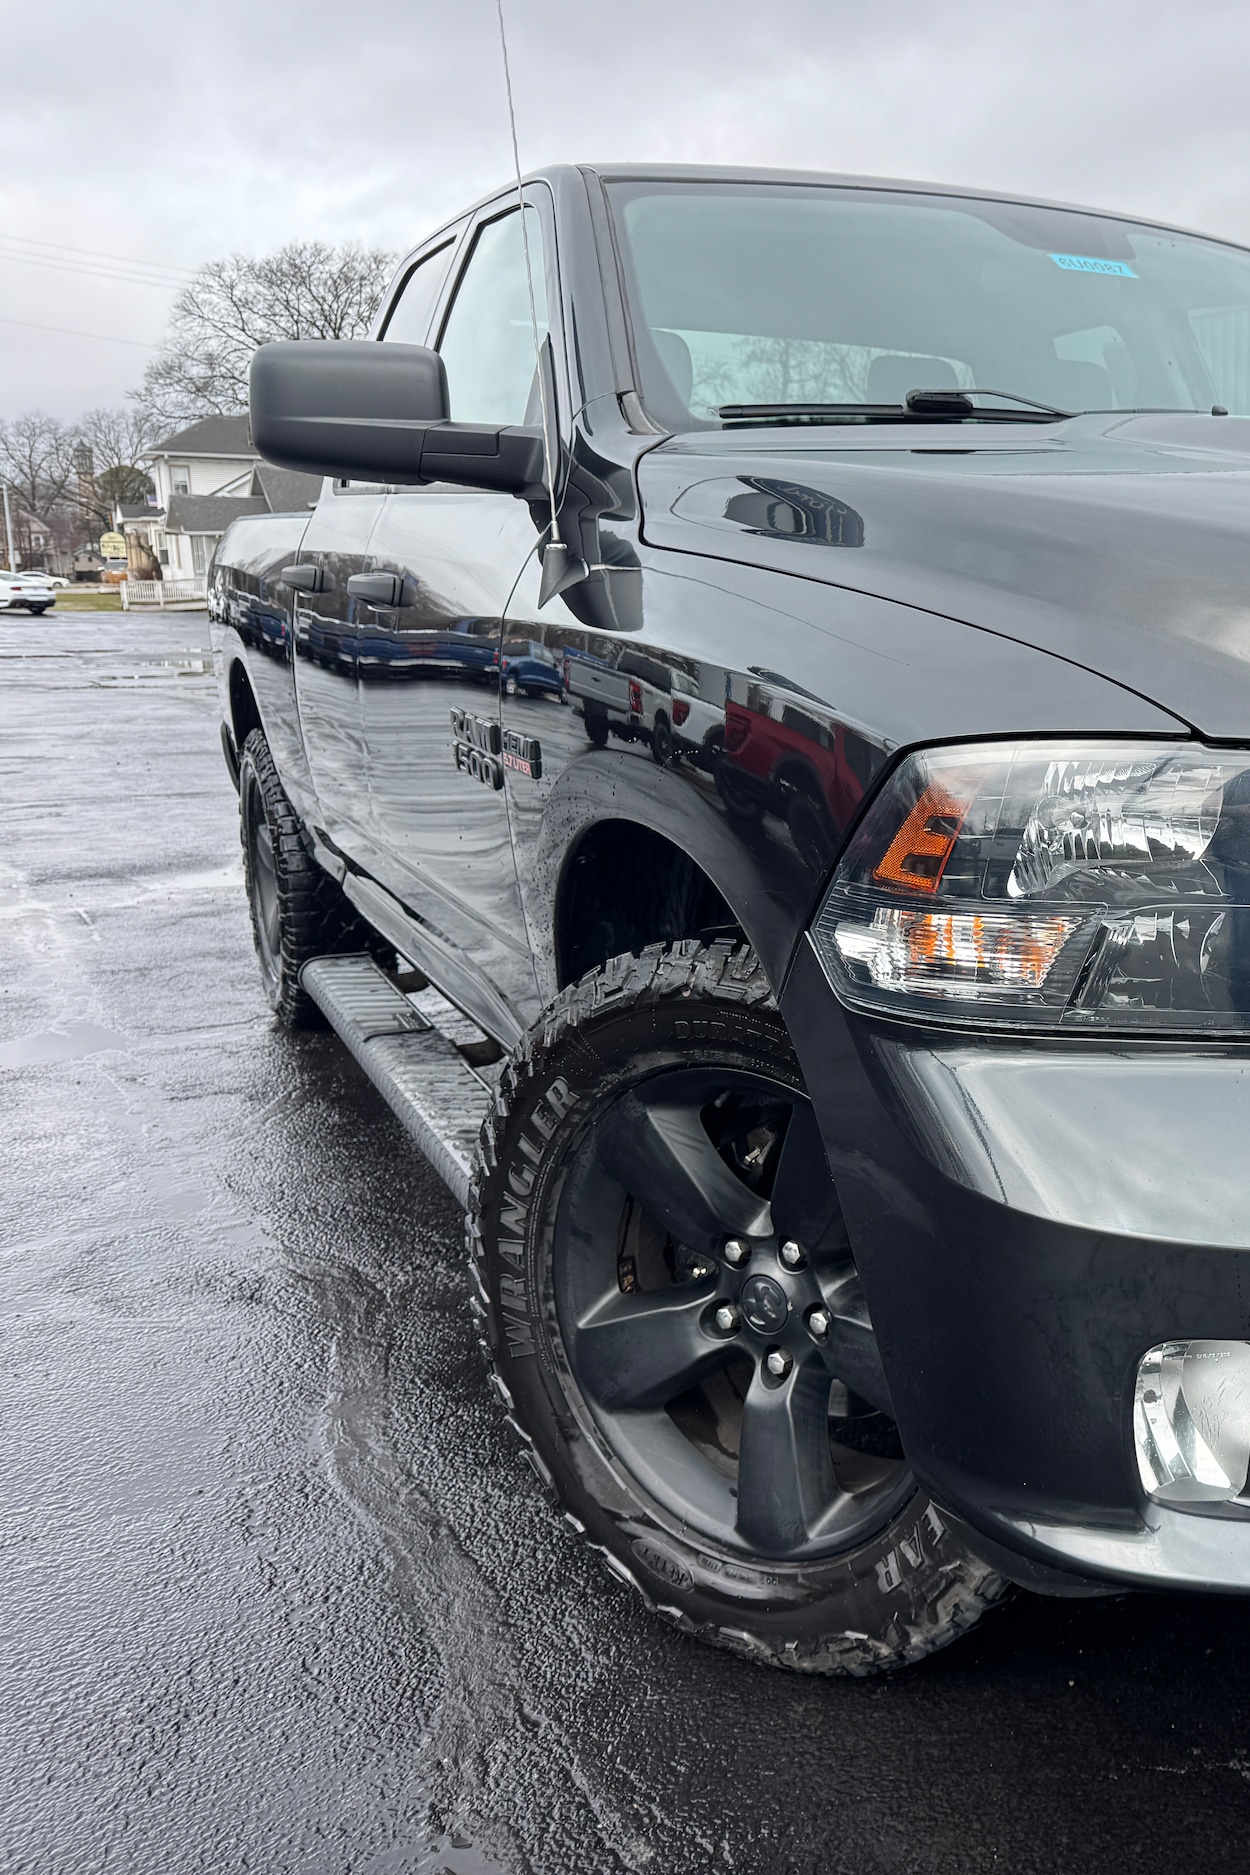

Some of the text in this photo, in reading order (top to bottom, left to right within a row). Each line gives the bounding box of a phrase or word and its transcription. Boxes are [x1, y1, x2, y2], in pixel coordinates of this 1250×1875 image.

[450, 706, 500, 755] RAM
[502, 729, 540, 760] HEMI
[452, 740, 504, 790] 1500
[496, 1075, 581, 1358] WRANGLER
[873, 1499, 948, 1595] EAR
